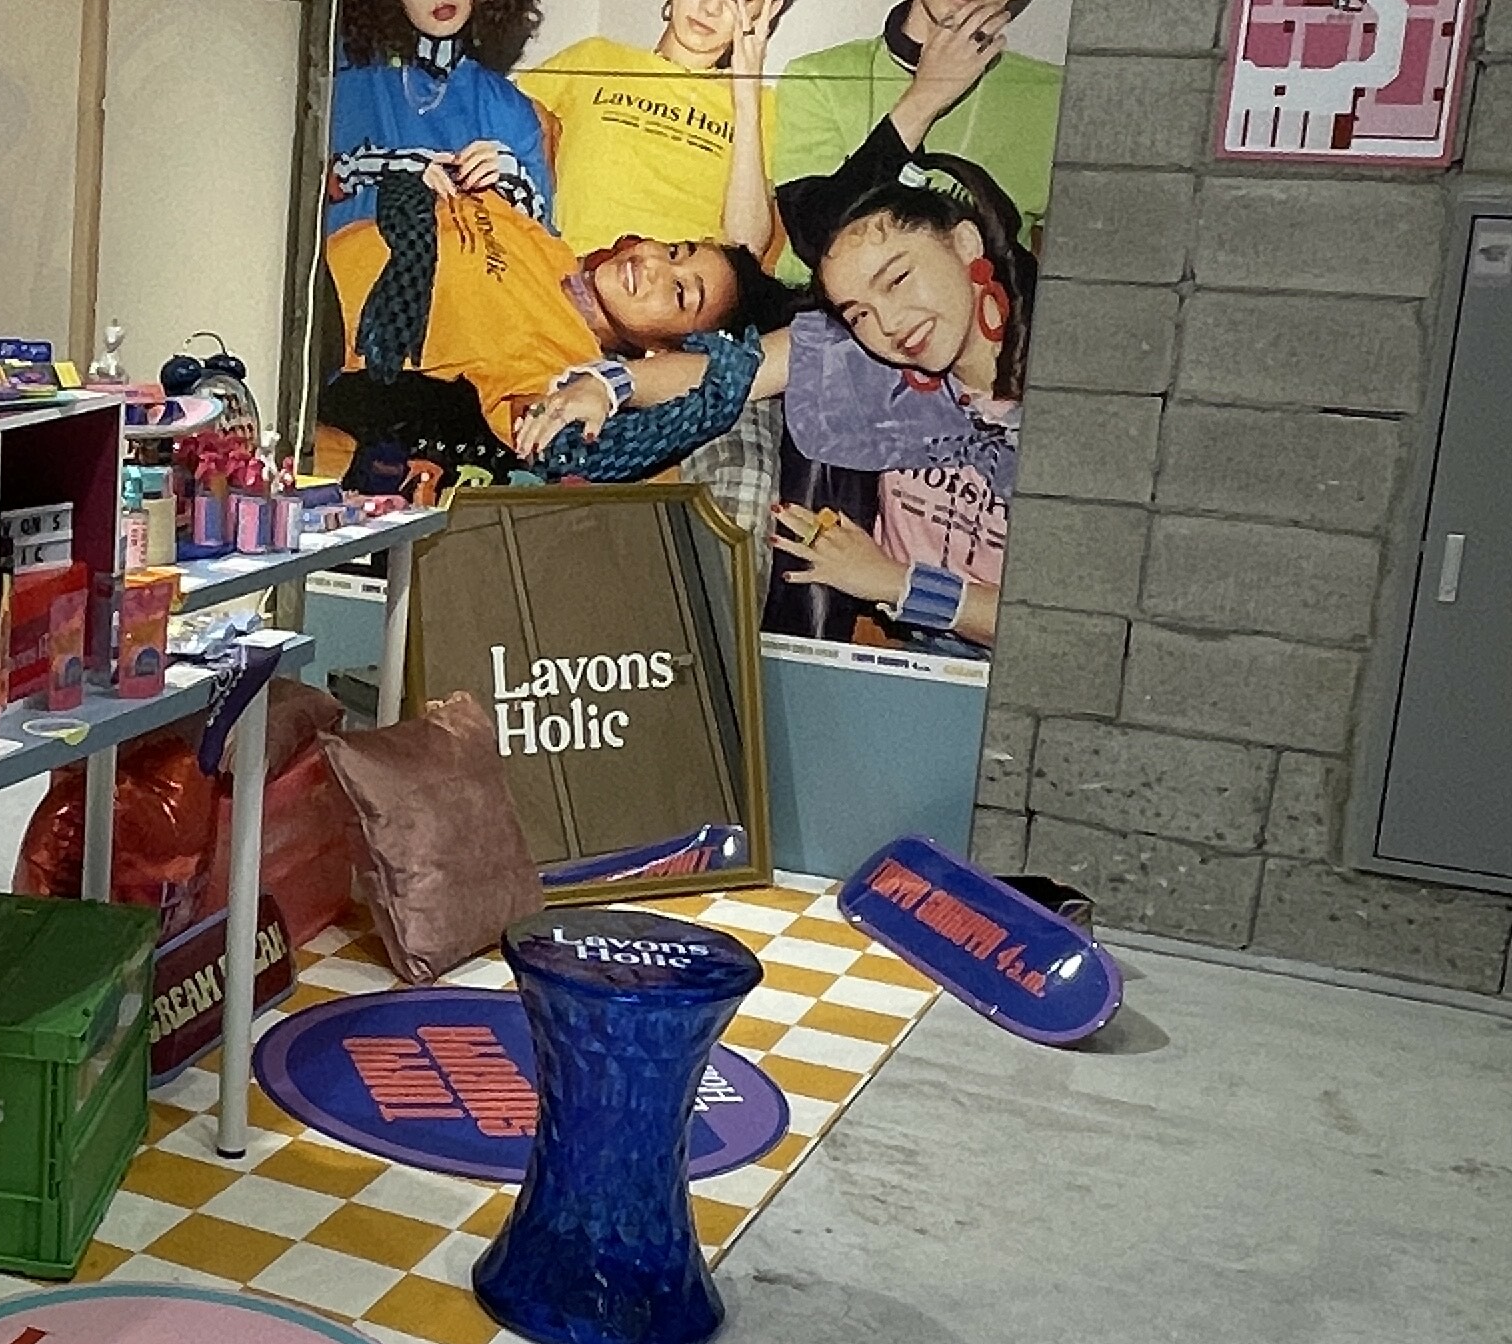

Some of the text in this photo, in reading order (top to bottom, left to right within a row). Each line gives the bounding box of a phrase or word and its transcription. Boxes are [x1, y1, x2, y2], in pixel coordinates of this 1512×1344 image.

[592, 86, 681, 122] Lavons
[490, 645, 674, 700] Lavons
[494, 696, 630, 756] Holic
[552, 926, 710, 956] Lavons
[576, 943, 692, 969] Holic
